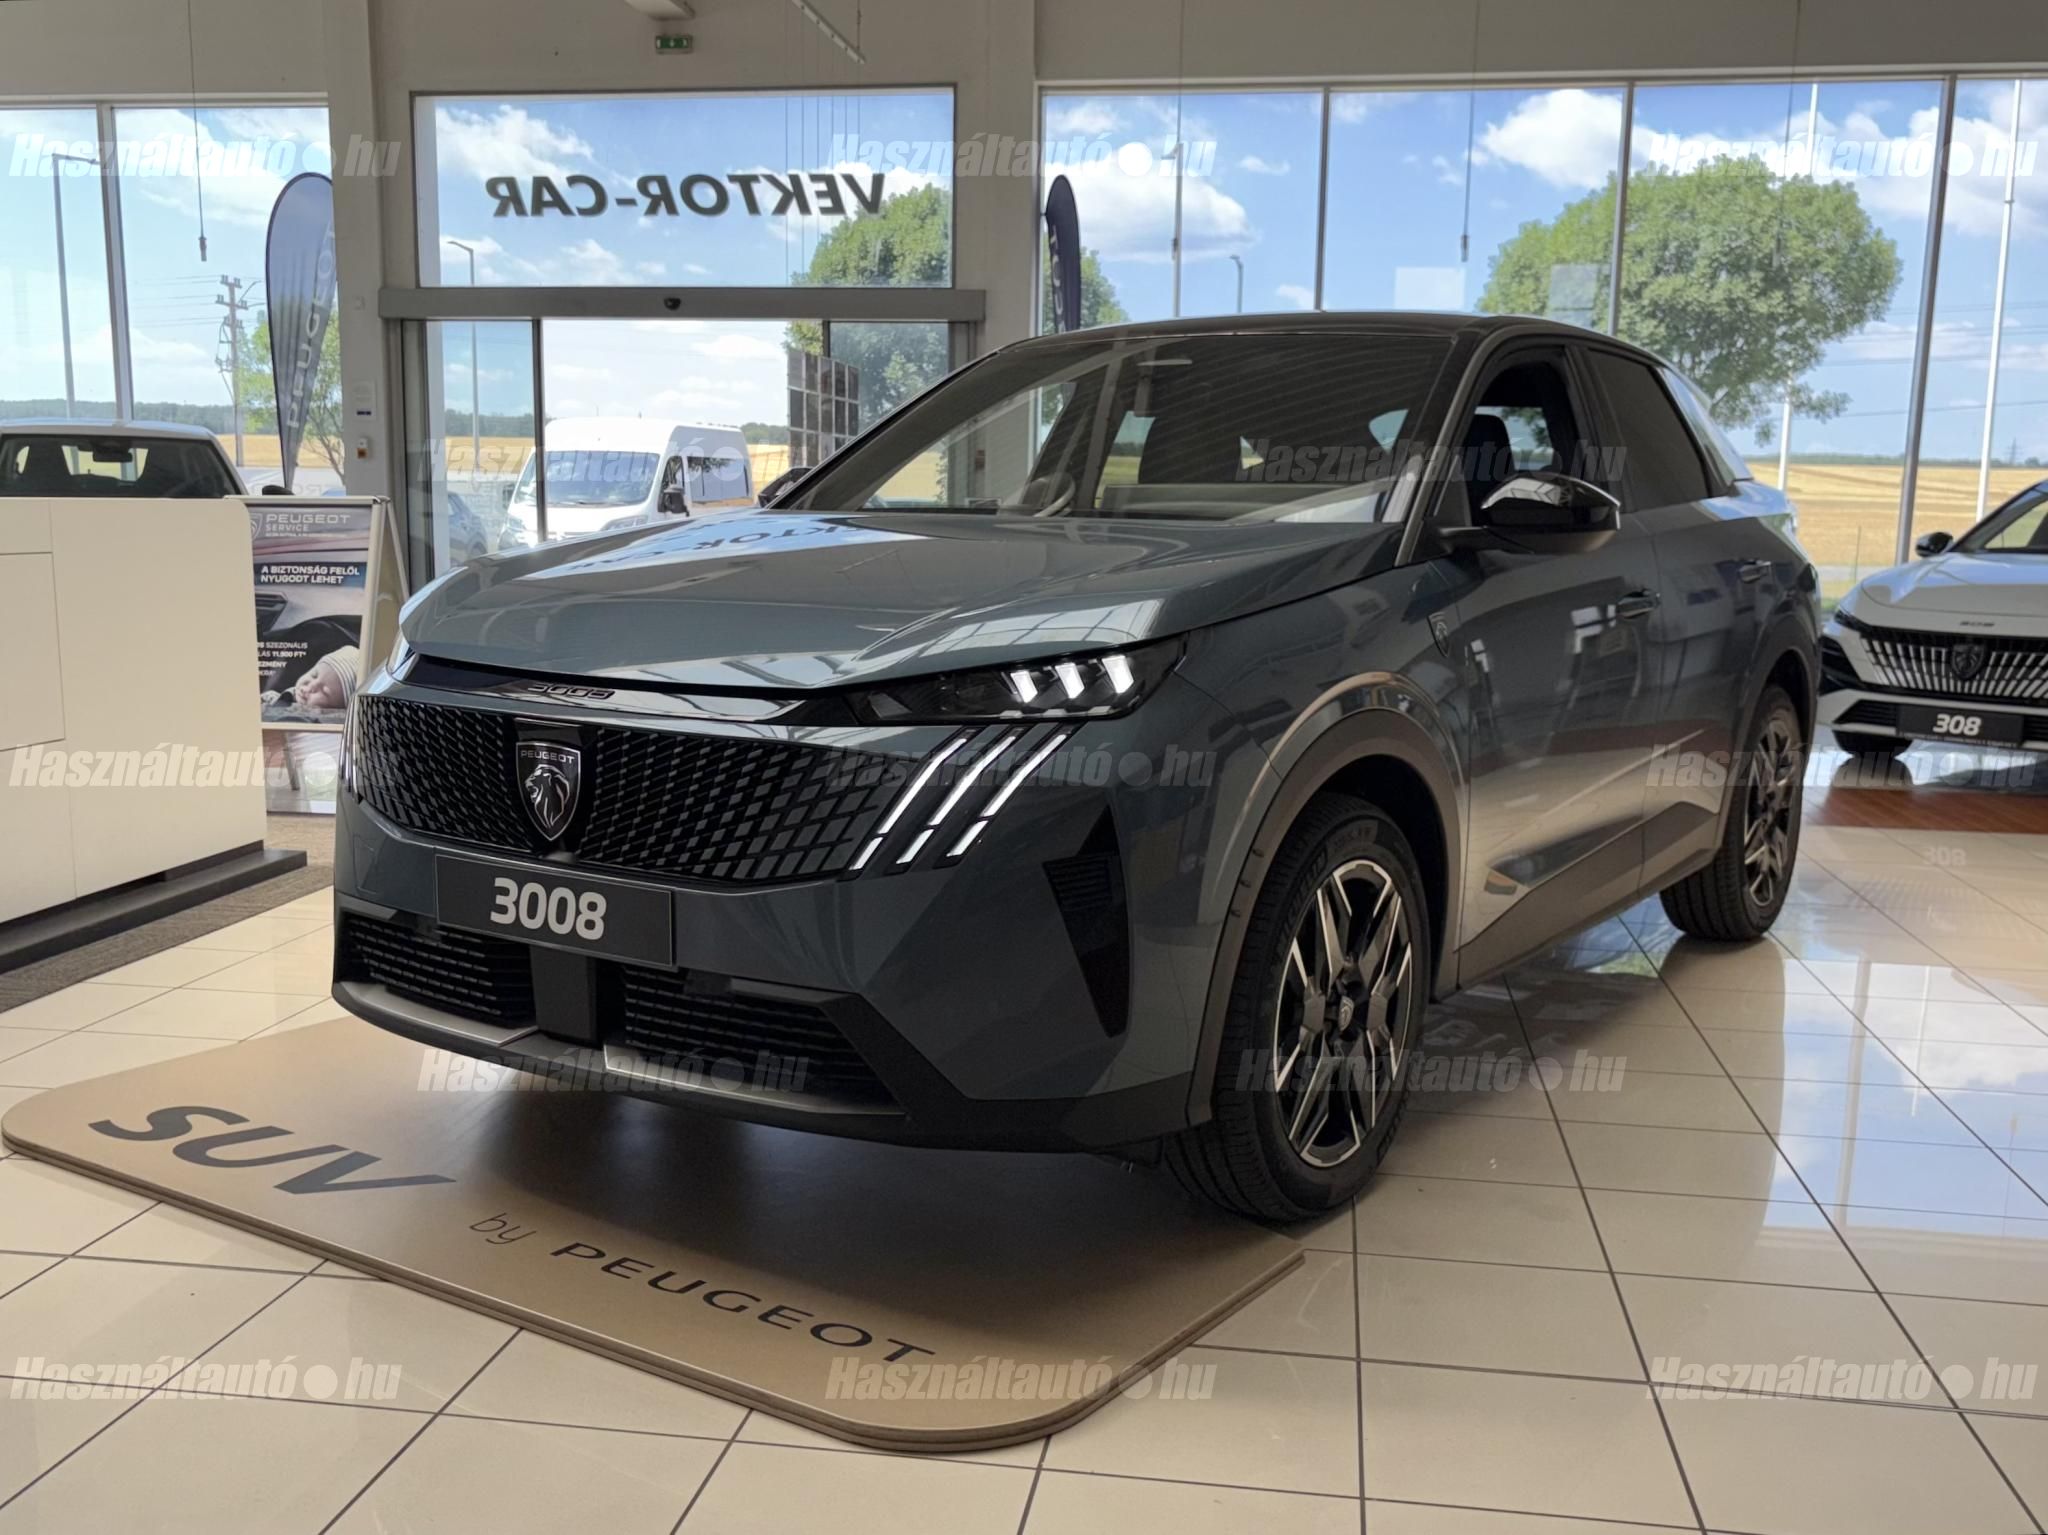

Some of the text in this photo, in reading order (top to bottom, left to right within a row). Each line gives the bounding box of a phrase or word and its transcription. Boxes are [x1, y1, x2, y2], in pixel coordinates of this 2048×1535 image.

[265, 513, 351, 524] PEUGEOT
[265, 523, 309, 532] SERVICE
[261, 566, 268, 574] A
[270, 564, 328, 575] BIZTONSÁG
[260, 575, 344, 584] NYUGODT LEHET
[1932, 713, 1982, 736] 308
[520, 751, 575, 764] PEUGEOT
[490, 877, 607, 940] 3008
[87, 1105, 457, 1196] SUV
[468, 1212, 936, 1363] by PEUGEOT
